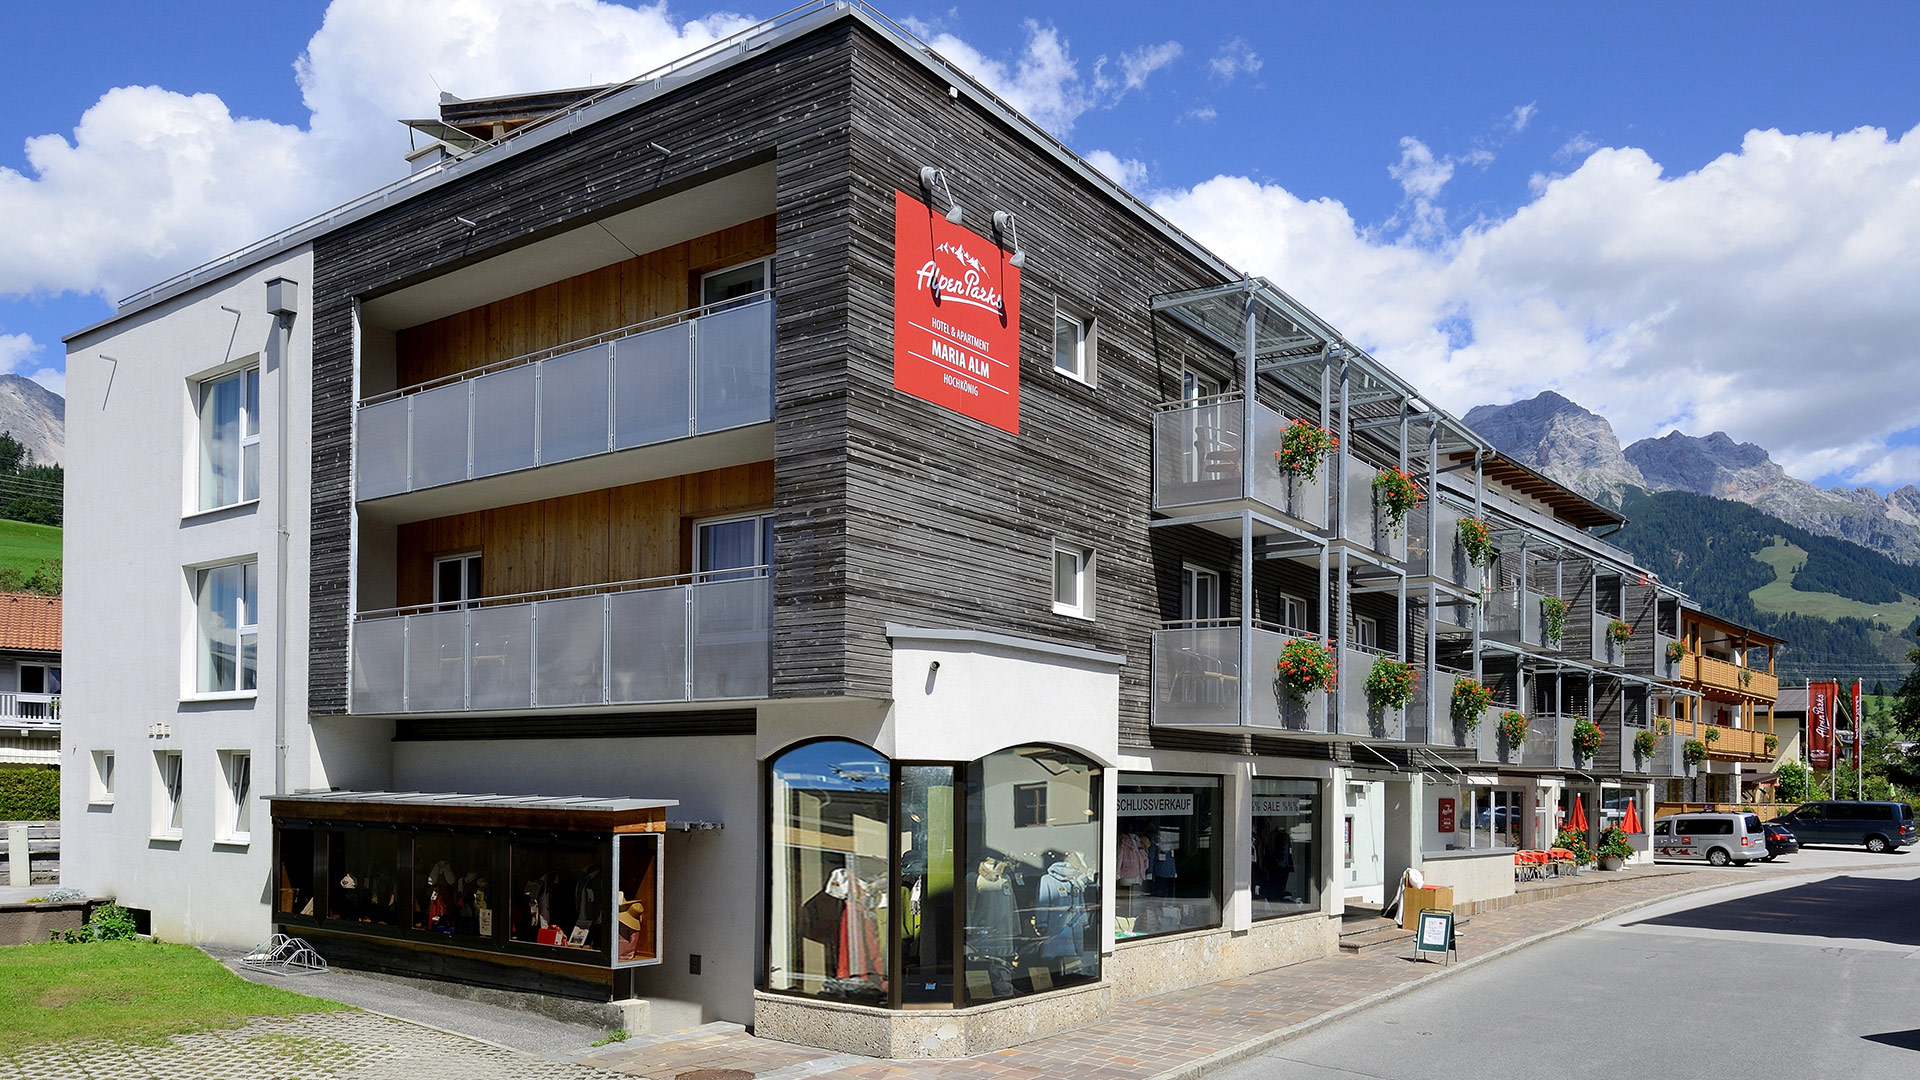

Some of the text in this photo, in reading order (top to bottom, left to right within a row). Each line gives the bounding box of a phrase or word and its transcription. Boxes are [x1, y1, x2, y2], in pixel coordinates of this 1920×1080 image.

[932, 317, 990, 352] HOTEL & APARTMENT
[932, 341, 990, 378] MARIA ALM
[944, 374, 978, 396] HOCHKÖNIG
[1263, 801, 1280, 811] SALE
